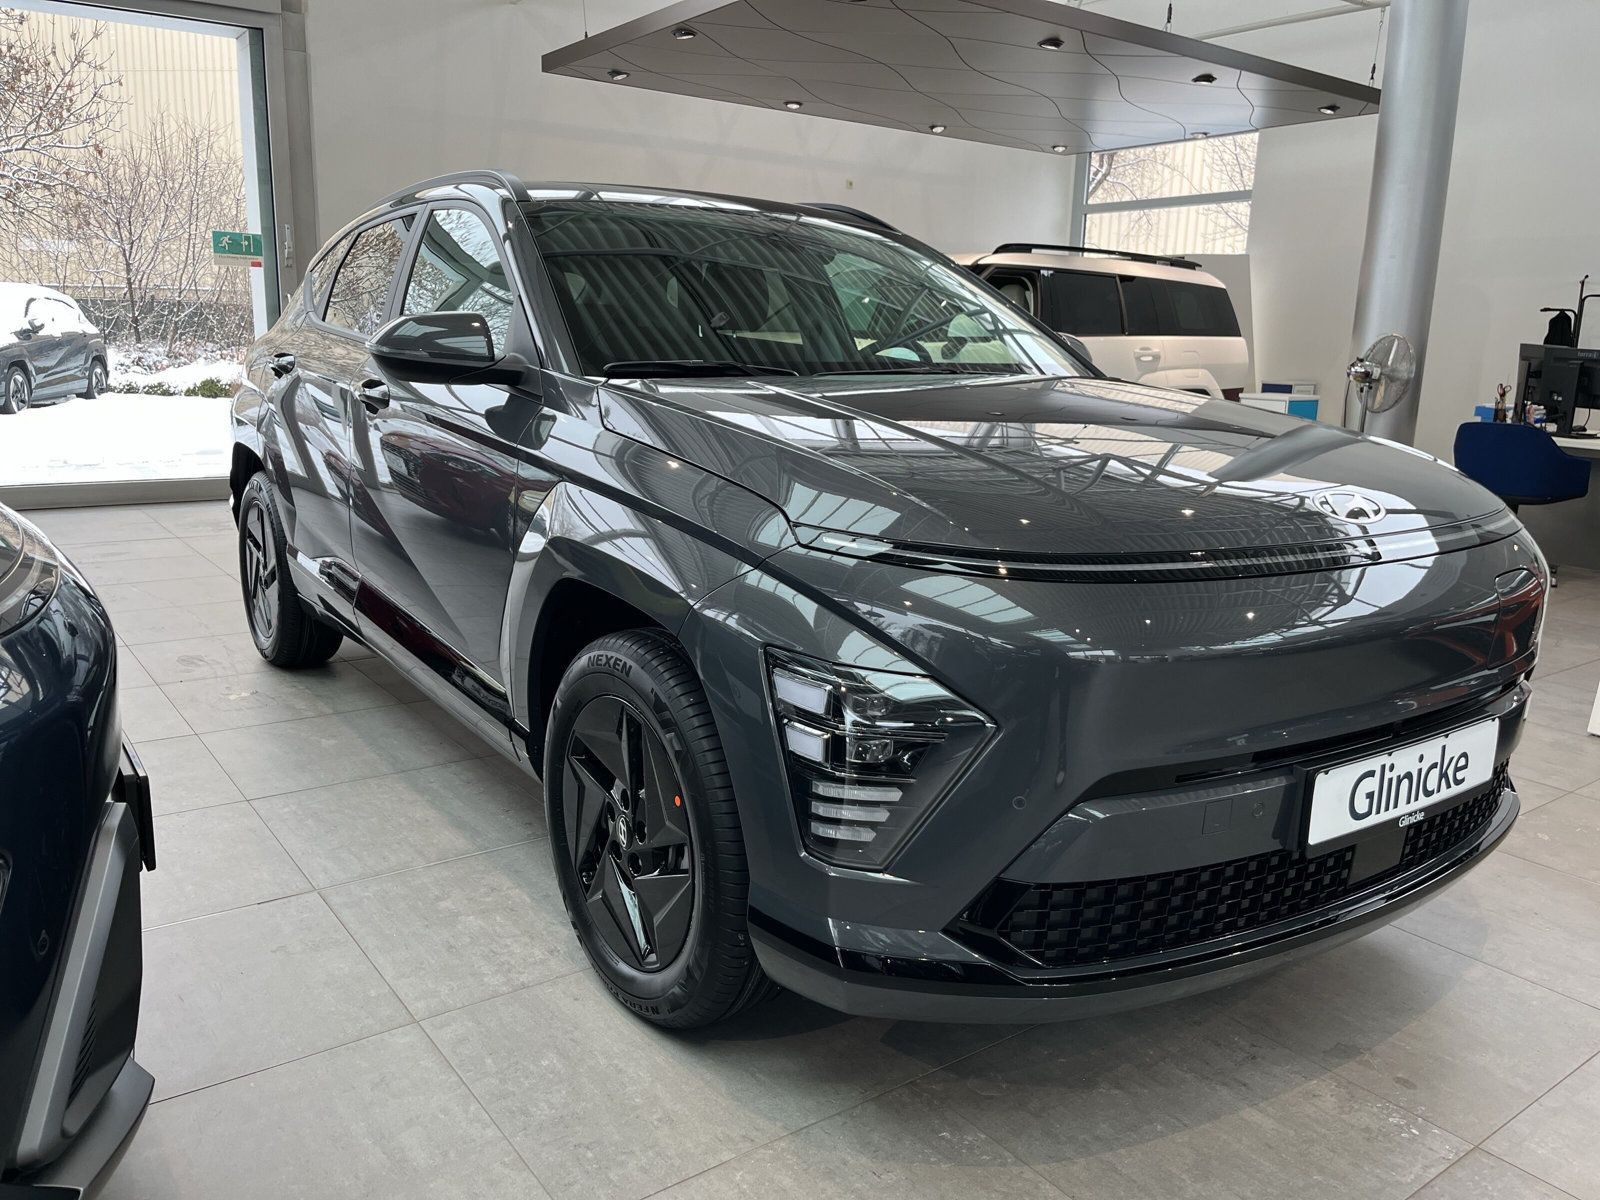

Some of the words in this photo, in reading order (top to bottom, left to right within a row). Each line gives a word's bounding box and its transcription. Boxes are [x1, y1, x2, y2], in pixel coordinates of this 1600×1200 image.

[587, 654, 632, 678] NEXEN
[1350, 745, 1469, 821] Glinicke
[1399, 811, 1425, 828] Glinicke
